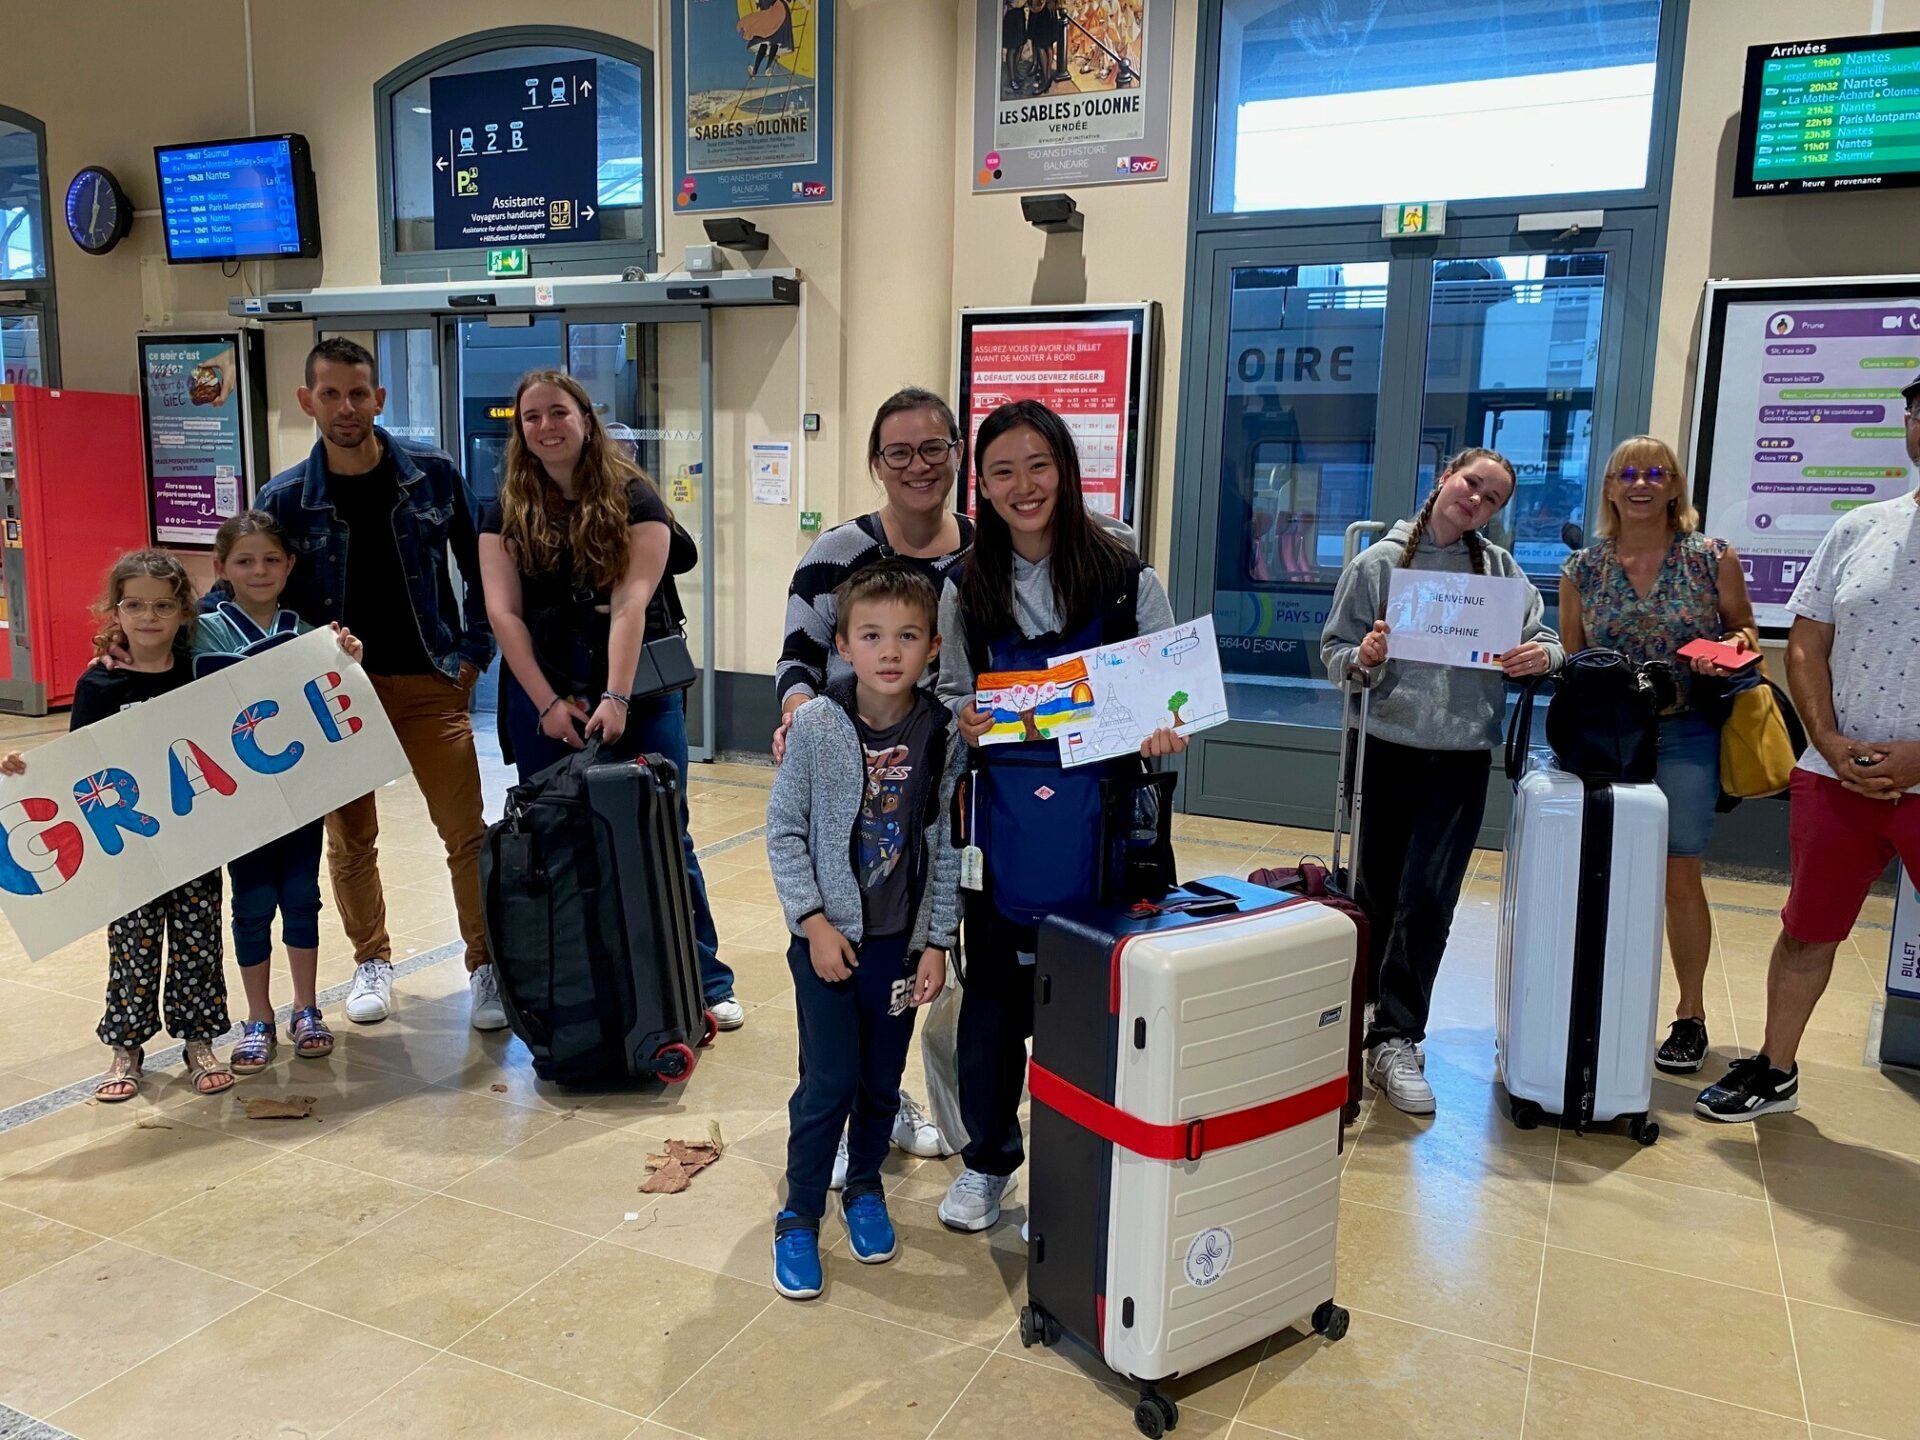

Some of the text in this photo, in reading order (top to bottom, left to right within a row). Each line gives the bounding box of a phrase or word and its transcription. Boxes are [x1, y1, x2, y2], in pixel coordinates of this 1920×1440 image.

[1771, 43, 1827, 57] Arrivées
[1846, 53, 1890, 65] Nantes
[1843, 61, 1920, 77] Belleville-sur-V
[1809, 78, 1888, 92] 20h32 Nantes
[528, 87, 537, 106] 1
[1788, 89, 1875, 105] La Mothe-Achard
[1841, 102, 1877, 112] Nantes
[999, 109, 1018, 125] LES
[1020, 102, 1070, 122] SABLES
[1048, 121, 1088, 133] VENDÉE
[1805, 118, 1832, 128] 22h19
[1839, 115, 1864, 125] Paris
[695, 122, 743, 140] SABLES
[1838, 127, 1873, 136] Nantes
[487, 130, 524, 151] 2 B
[1803, 139, 1872, 152] 11h01 Nantes
[203, 149, 230, 159] Saumur
[1043, 149, 1060, 157] ANS
[1835, 151, 1873, 161] Saumur
[1132, 160, 1158, 171] SNCF
[205, 171, 230, 180] Nantes
[457, 170, 470, 193] P
[1755, 183, 1774, 191] train
[1802, 179, 1825, 188] heure
[1834, 176, 1882, 187] provenance
[208, 193, 229, 201] Nantes
[804, 186, 826, 196] SNCF
[209, 203, 222, 211] Paris
[223, 201, 264, 211] Montparnasse
[492, 196, 545, 209] Assistance
[210, 214, 231, 222] Nantes
[471, 209, 545, 224] Voyageurs handicapés
[211, 225, 232, 233] Nantes
[213, 235, 233, 243] Nantes
[1802, 322, 1824, 330] Prune
[975, 343, 1101, 353] ASSUREZ-VOUS D'AVOIR UN BILLET
[149, 350, 200, 361] ce soir c'est
[975, 355, 999, 363] AVANT
[1001, 354, 1011, 362] DE
[1013, 354, 1045, 362] MONTER
[1054, 353, 1076, 361] BORD
[1016, 373, 1036, 381] VOUS
[1038, 373, 1068, 381] DEVREZ
[1070, 371, 1101, 381] RÉGLER
[1794, 375, 1811, 383] billet
[1429, 592, 1485, 606] BIENVENUE
[1276, 610, 1310, 623] PAYS
[1426, 624, 1480, 637] JOSEPHINE
[1219, 636, 1251, 650] 564-0
[0, 672, 363, 896] GRACE
[1901, 942, 1916, 977] BILLET
